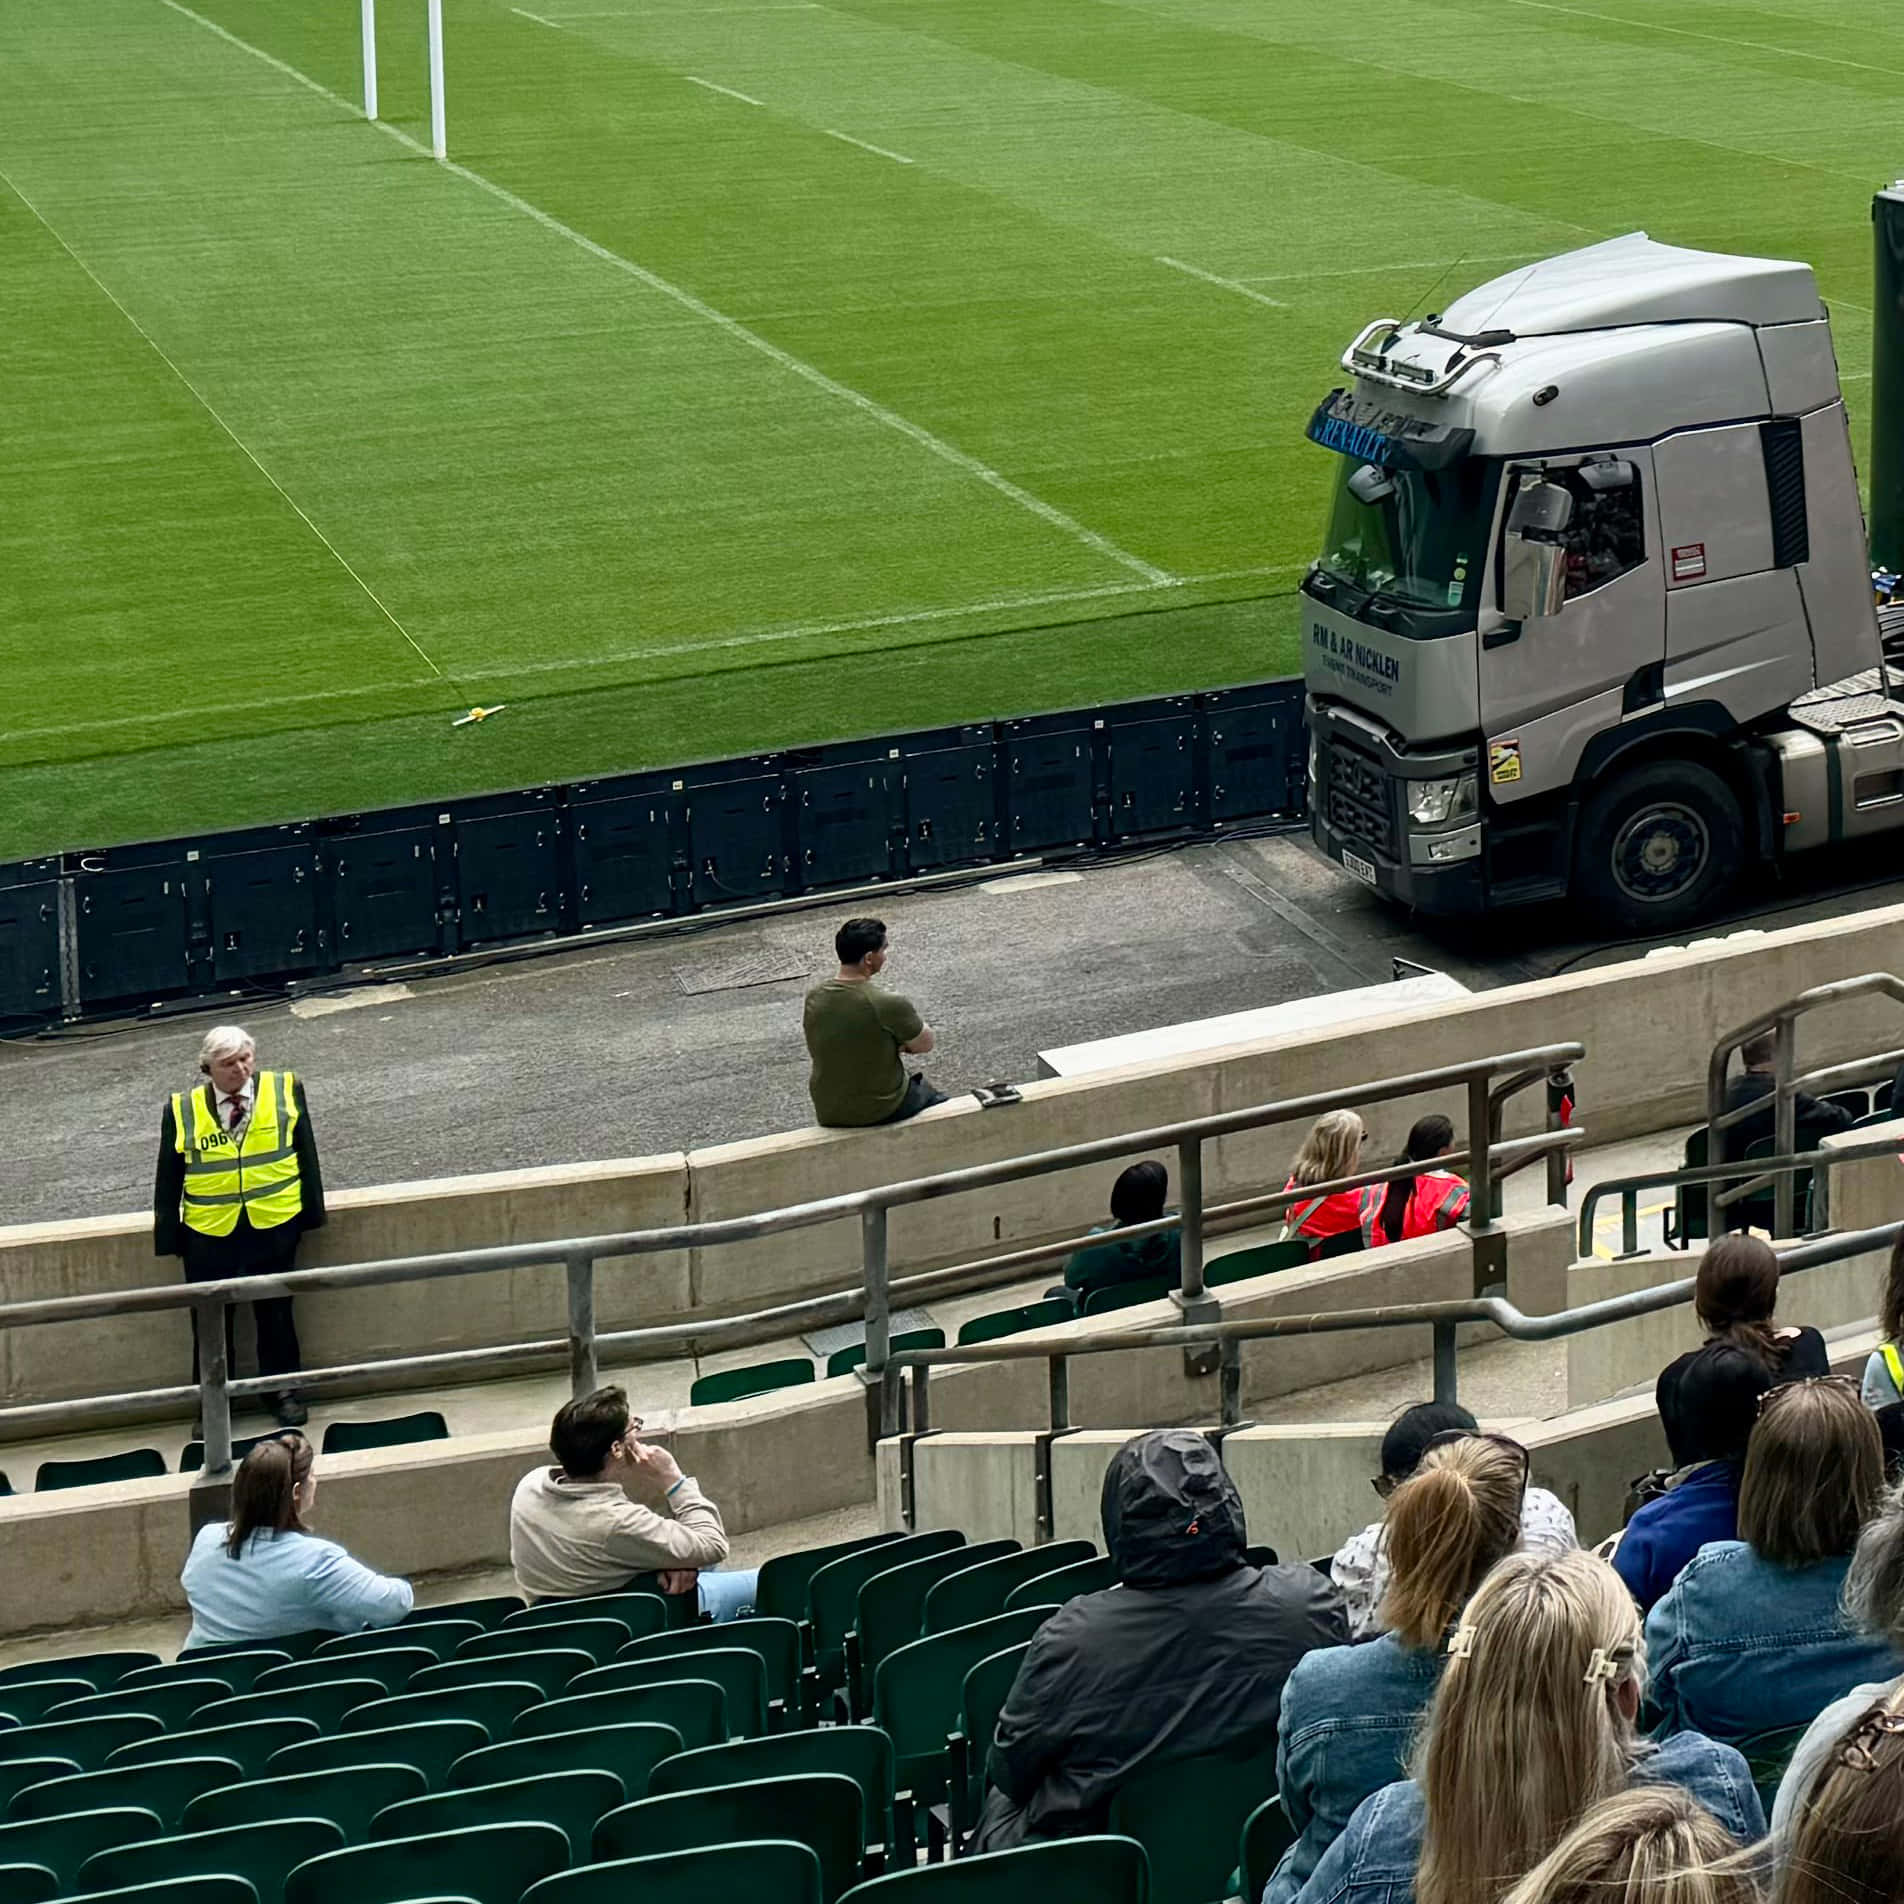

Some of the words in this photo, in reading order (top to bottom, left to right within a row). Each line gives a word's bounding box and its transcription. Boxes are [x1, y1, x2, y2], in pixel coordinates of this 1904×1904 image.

[1320, 417, 1387, 463] RENAULT
[1313, 622, 1329, 649] RM
[1330, 631, 1338, 654] &
[1340, 636, 1353, 662] AR
[1355, 642, 1399, 683] NICKLEN
[200, 1132, 228, 1151] 096
